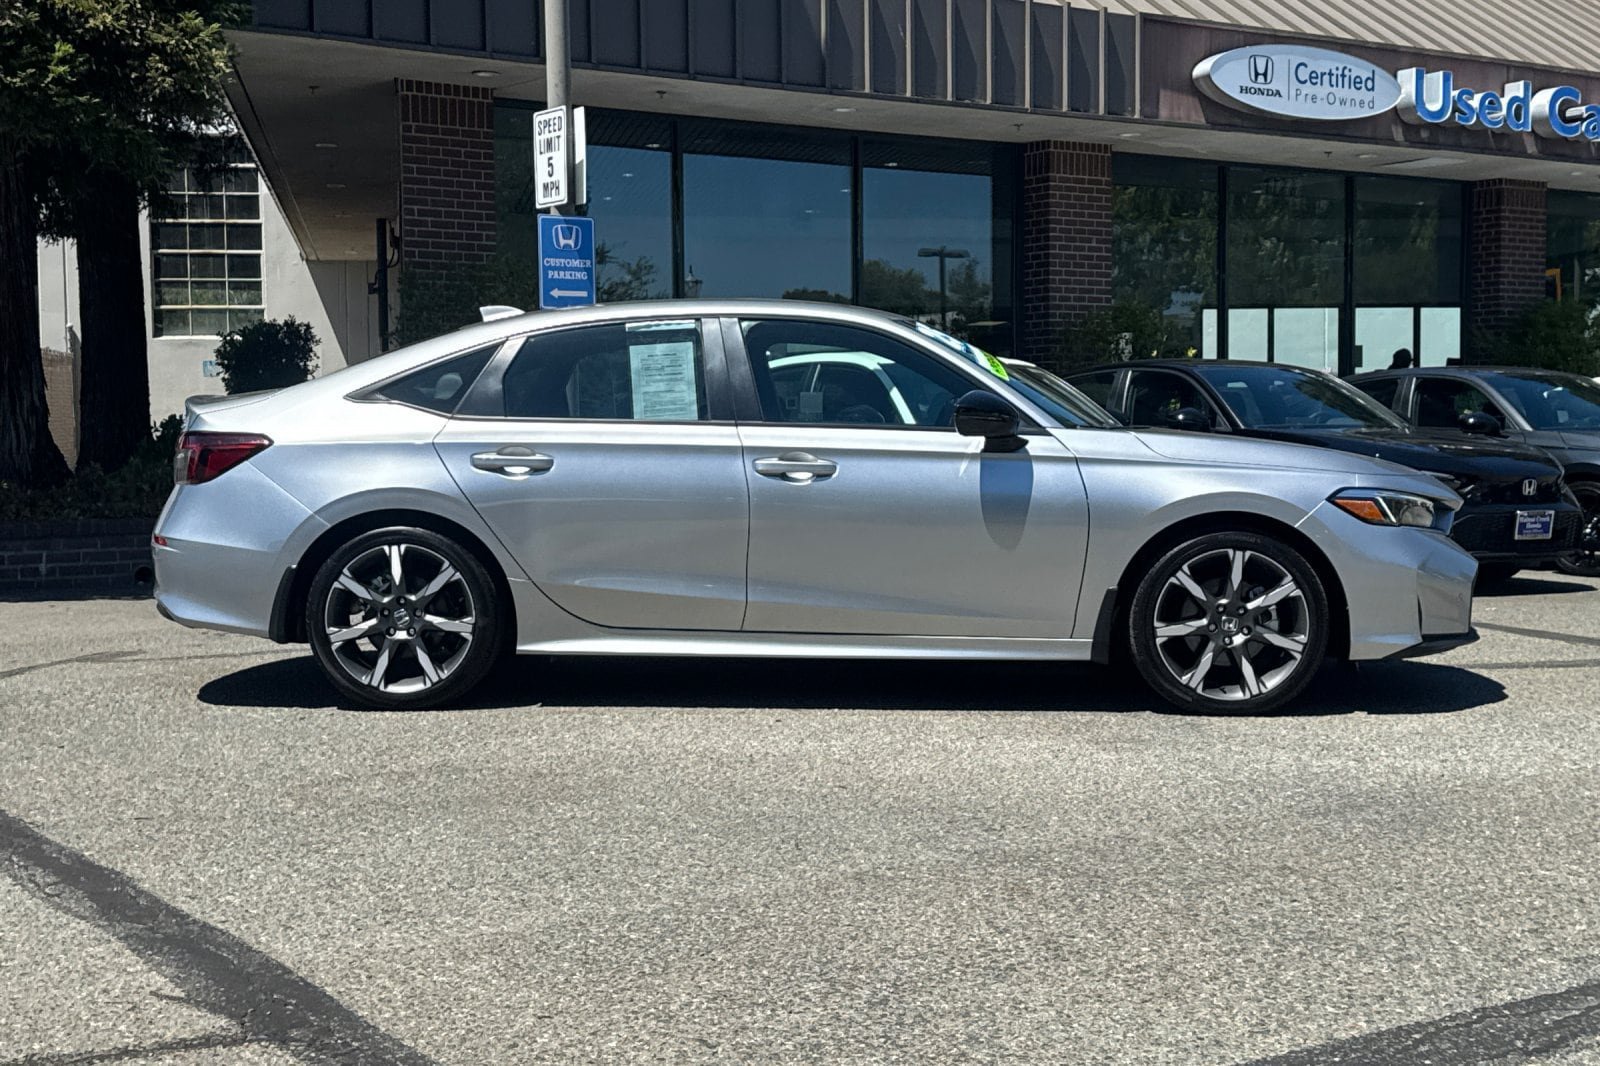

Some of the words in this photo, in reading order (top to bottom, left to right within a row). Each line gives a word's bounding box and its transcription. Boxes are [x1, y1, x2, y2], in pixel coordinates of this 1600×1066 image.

[1294, 61, 1376, 92] Certified
[1239, 84, 1283, 98] HONDA
[1295, 88, 1376, 110] Pre-Owned
[1414, 67, 1532, 132] Used
[1548, 85, 1600, 140] Ca
[538, 116, 563, 136] SPEED
[538, 134, 562, 156] LIMIT
[547, 157, 554, 178] 5
[542, 179, 561, 199] MPH
[543, 257, 592, 269] CUSTOMER
[547, 270, 588, 281] PARKING
